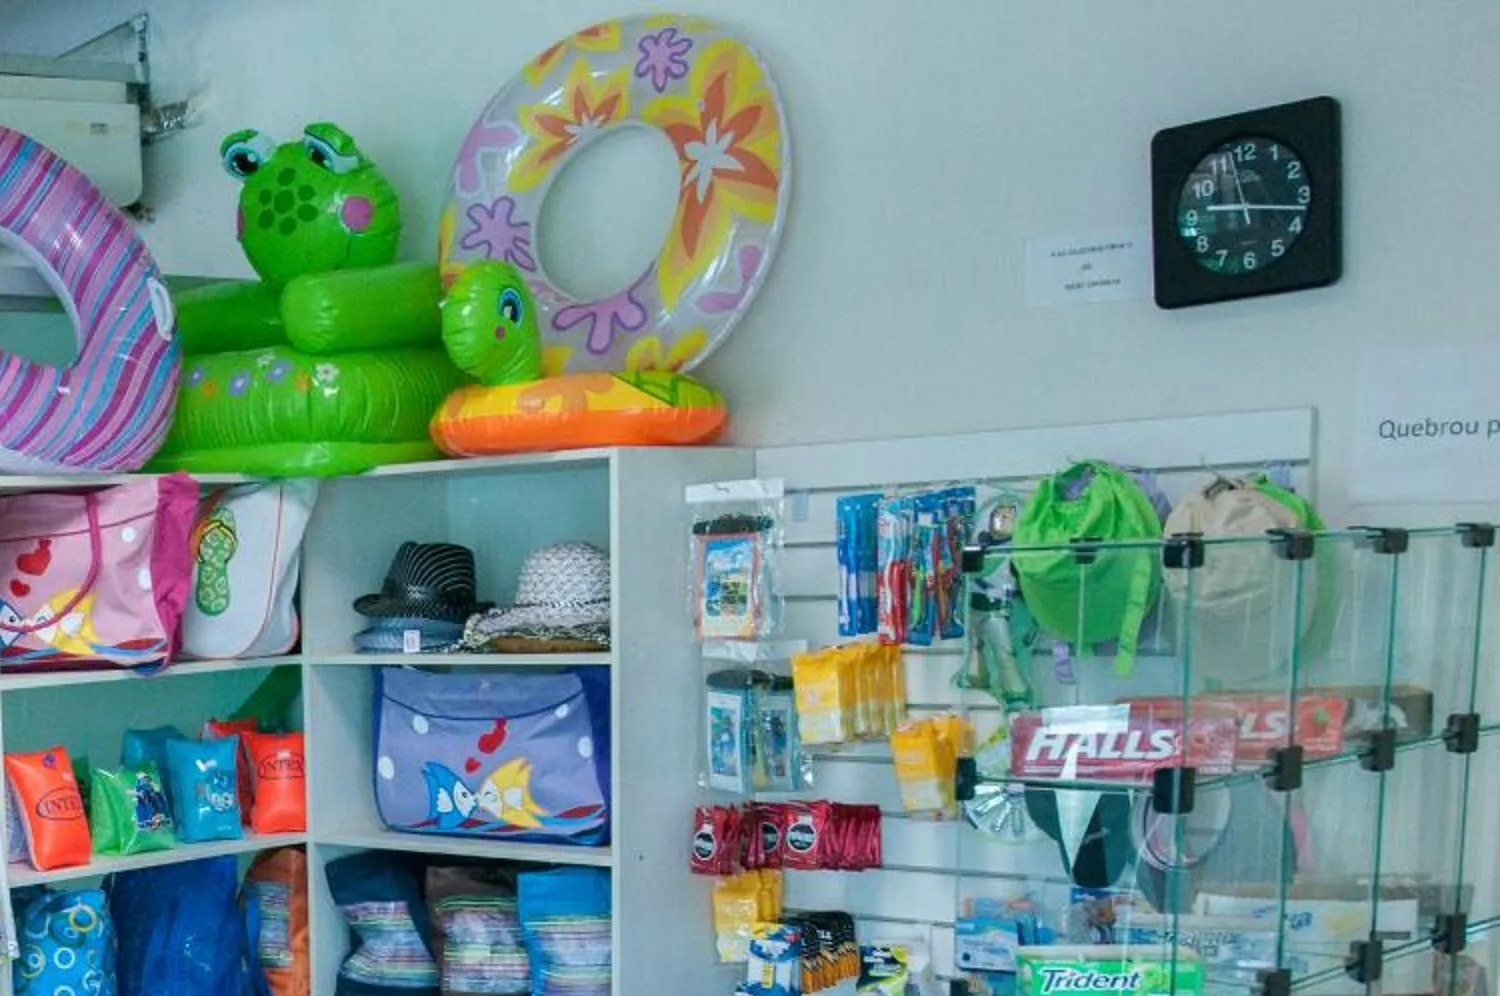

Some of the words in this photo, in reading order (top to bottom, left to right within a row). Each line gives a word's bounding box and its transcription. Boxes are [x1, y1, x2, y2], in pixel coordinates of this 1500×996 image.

[1233, 143, 1257, 162] 12
[1269, 144, 1279, 161] 1
[1210, 156, 1228, 175] 11
[1287, 161, 1301, 180] 2
[1191, 180, 1215, 199] 10
[1298, 185, 1311, 204] 3
[1186, 209, 1198, 227] 9
[1288, 216, 1302, 233] 4
[1197, 236, 1209, 253] 8
[1271, 239, 1285, 257] 5
[1216, 250, 1228, 267] 7
[1243, 252, 1256, 269] 6
[1379, 417, 1479, 440] Quebrou
[1026, 726, 1175, 761] HALLS
[1041, 968, 1140, 993] Trident
